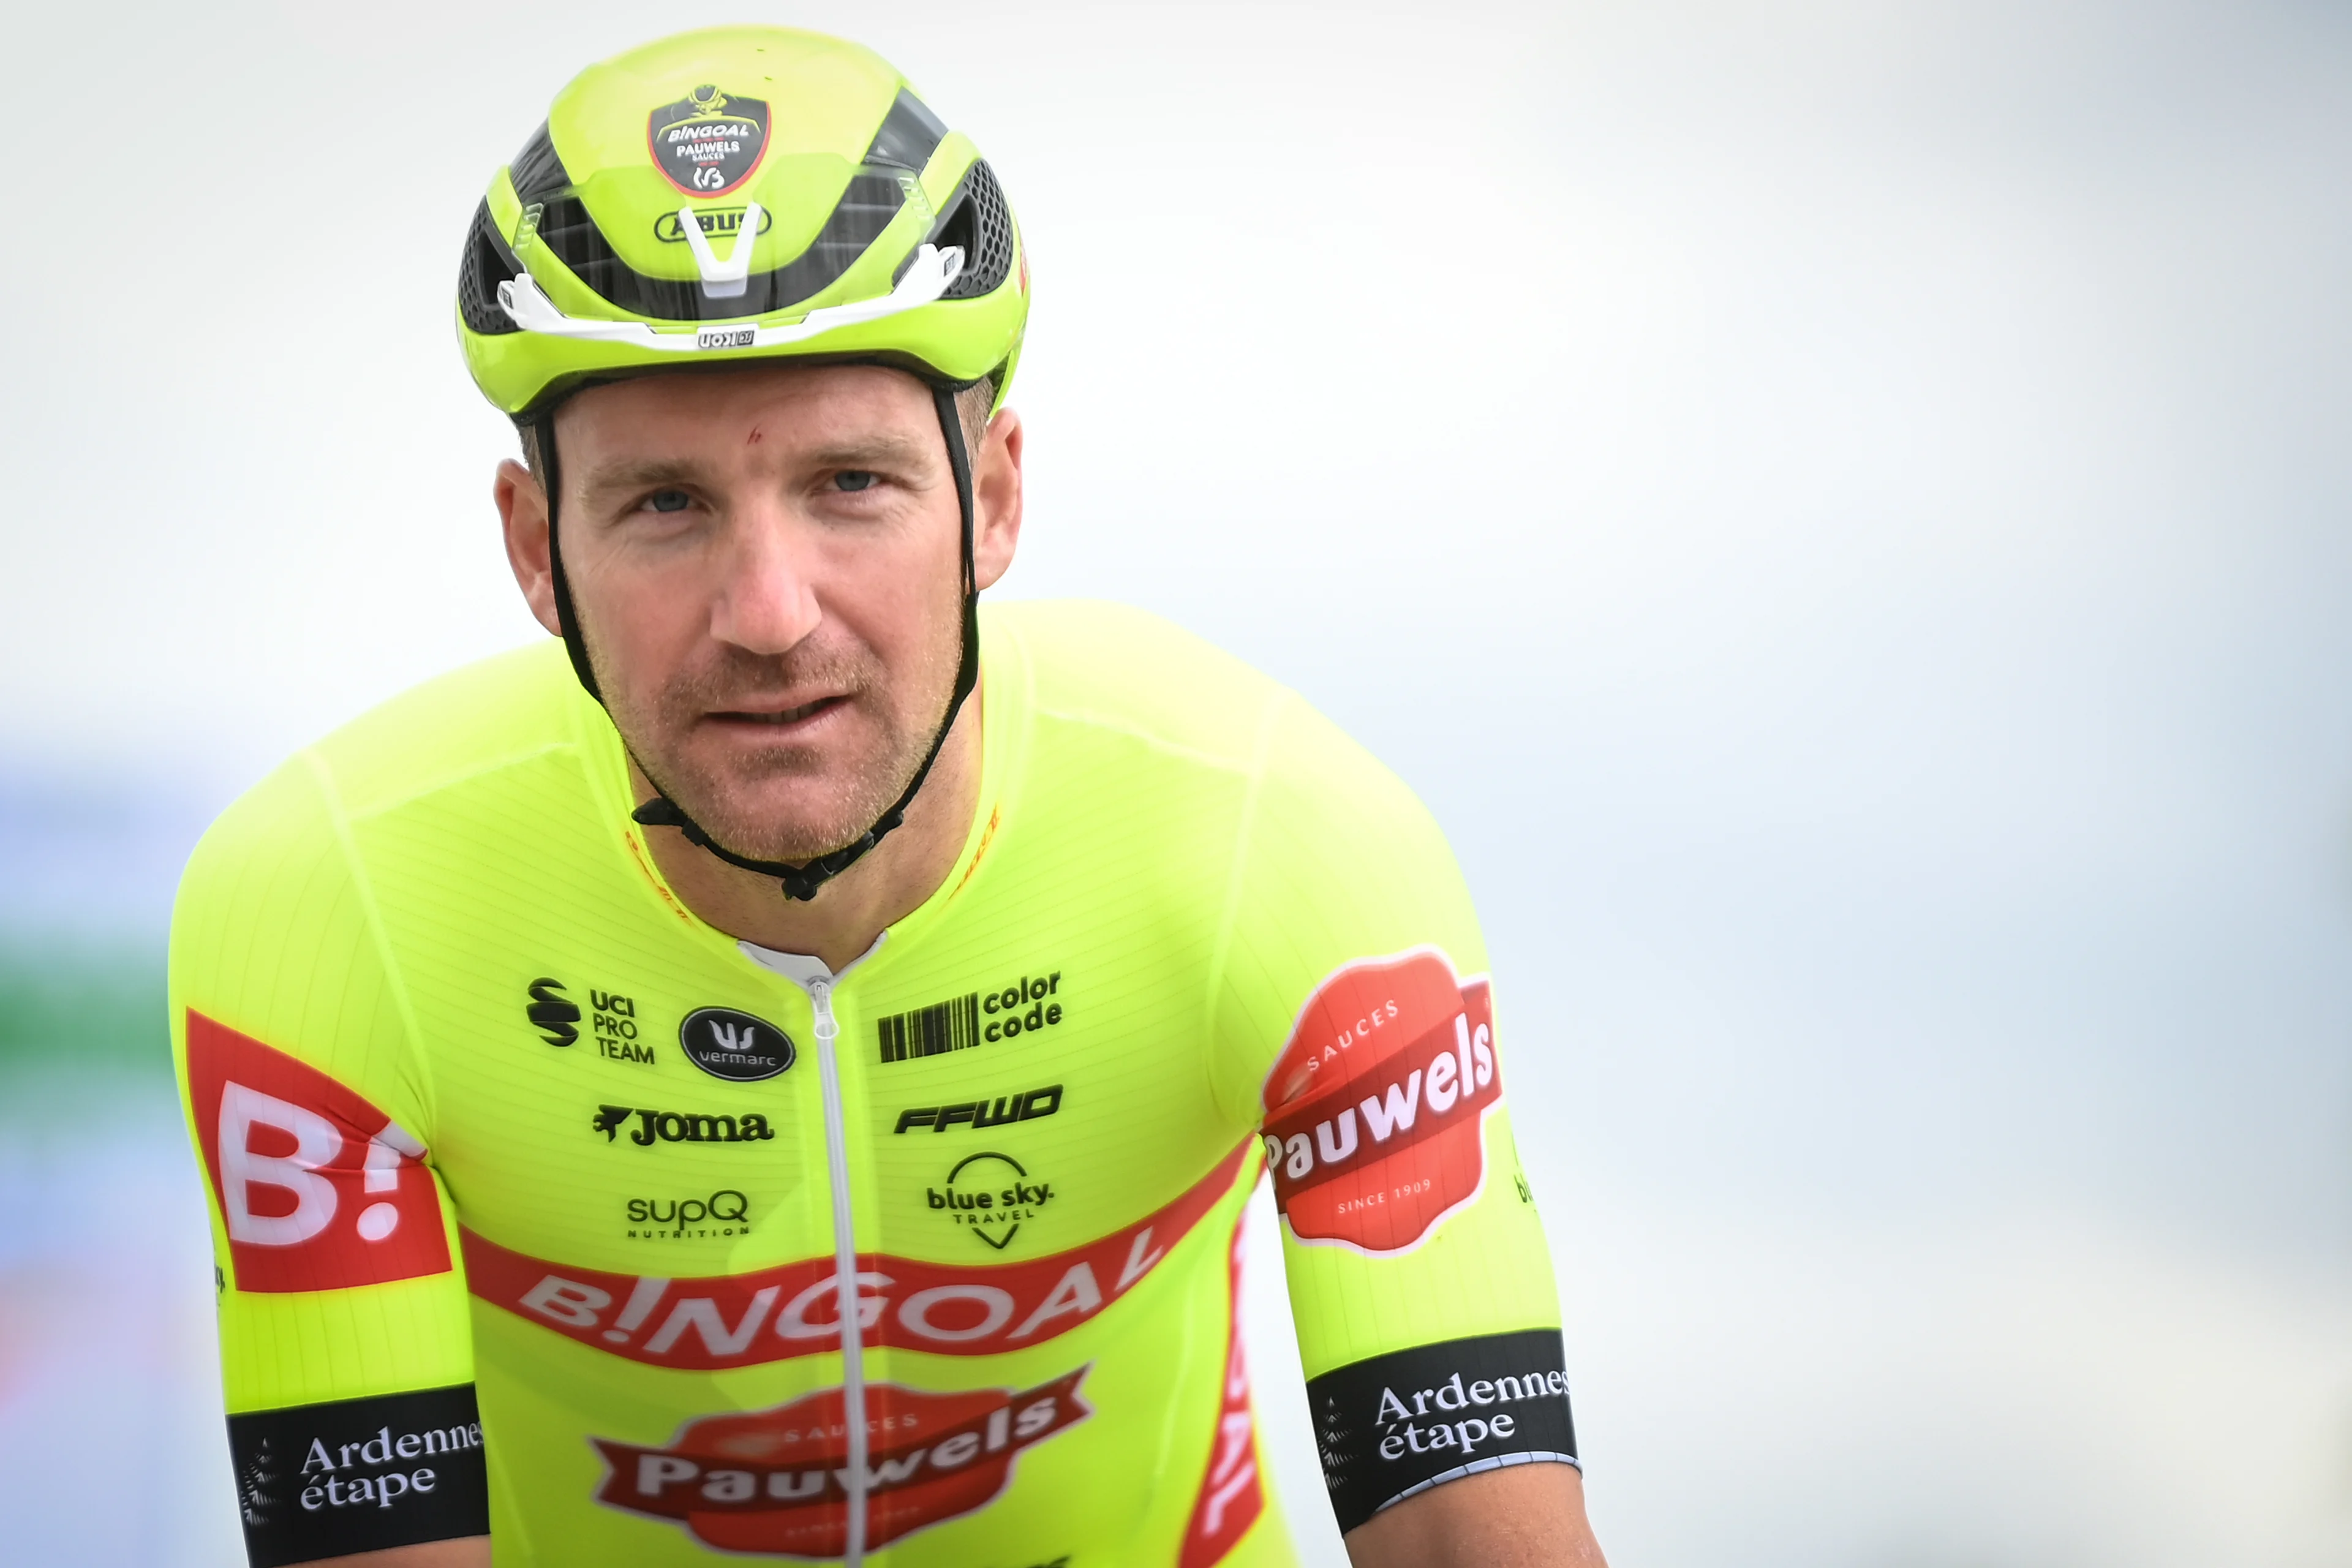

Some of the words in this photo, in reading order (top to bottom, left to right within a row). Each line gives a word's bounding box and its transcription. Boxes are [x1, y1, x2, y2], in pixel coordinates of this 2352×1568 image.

[676, 141, 740, 157] PAUWELS
[692, 153, 725, 162] SAUCES
[590, 989, 635, 1018] UCI
[983, 970, 1061, 1014] color
[593, 1012, 638, 1040] PRO
[984, 1001, 1063, 1042] code
[1306, 999, 1400, 1072] SAUCES
[595, 1036, 655, 1065] TEAM
[699, 1050, 776, 1066] vermarc
[894, 1084, 1063, 1134] FFWD
[1264, 1012, 1494, 1191] Pauwels
[627, 1189, 748, 1231] supQ
[927, 1188, 993, 1210] blue
[1000, 1182, 1055, 1207] sky.
[1338, 1193, 1385, 1214] SINCE
[1394, 1178, 1431, 1199] 1909
[627, 1227, 749, 1238] NUTRITION
[952, 1208, 1034, 1224] TRAVEL
[637, 1396, 1057, 1502] Pauwels
[1379, 1413, 1516, 1460] étape
[300, 1468, 435, 1510] étape
